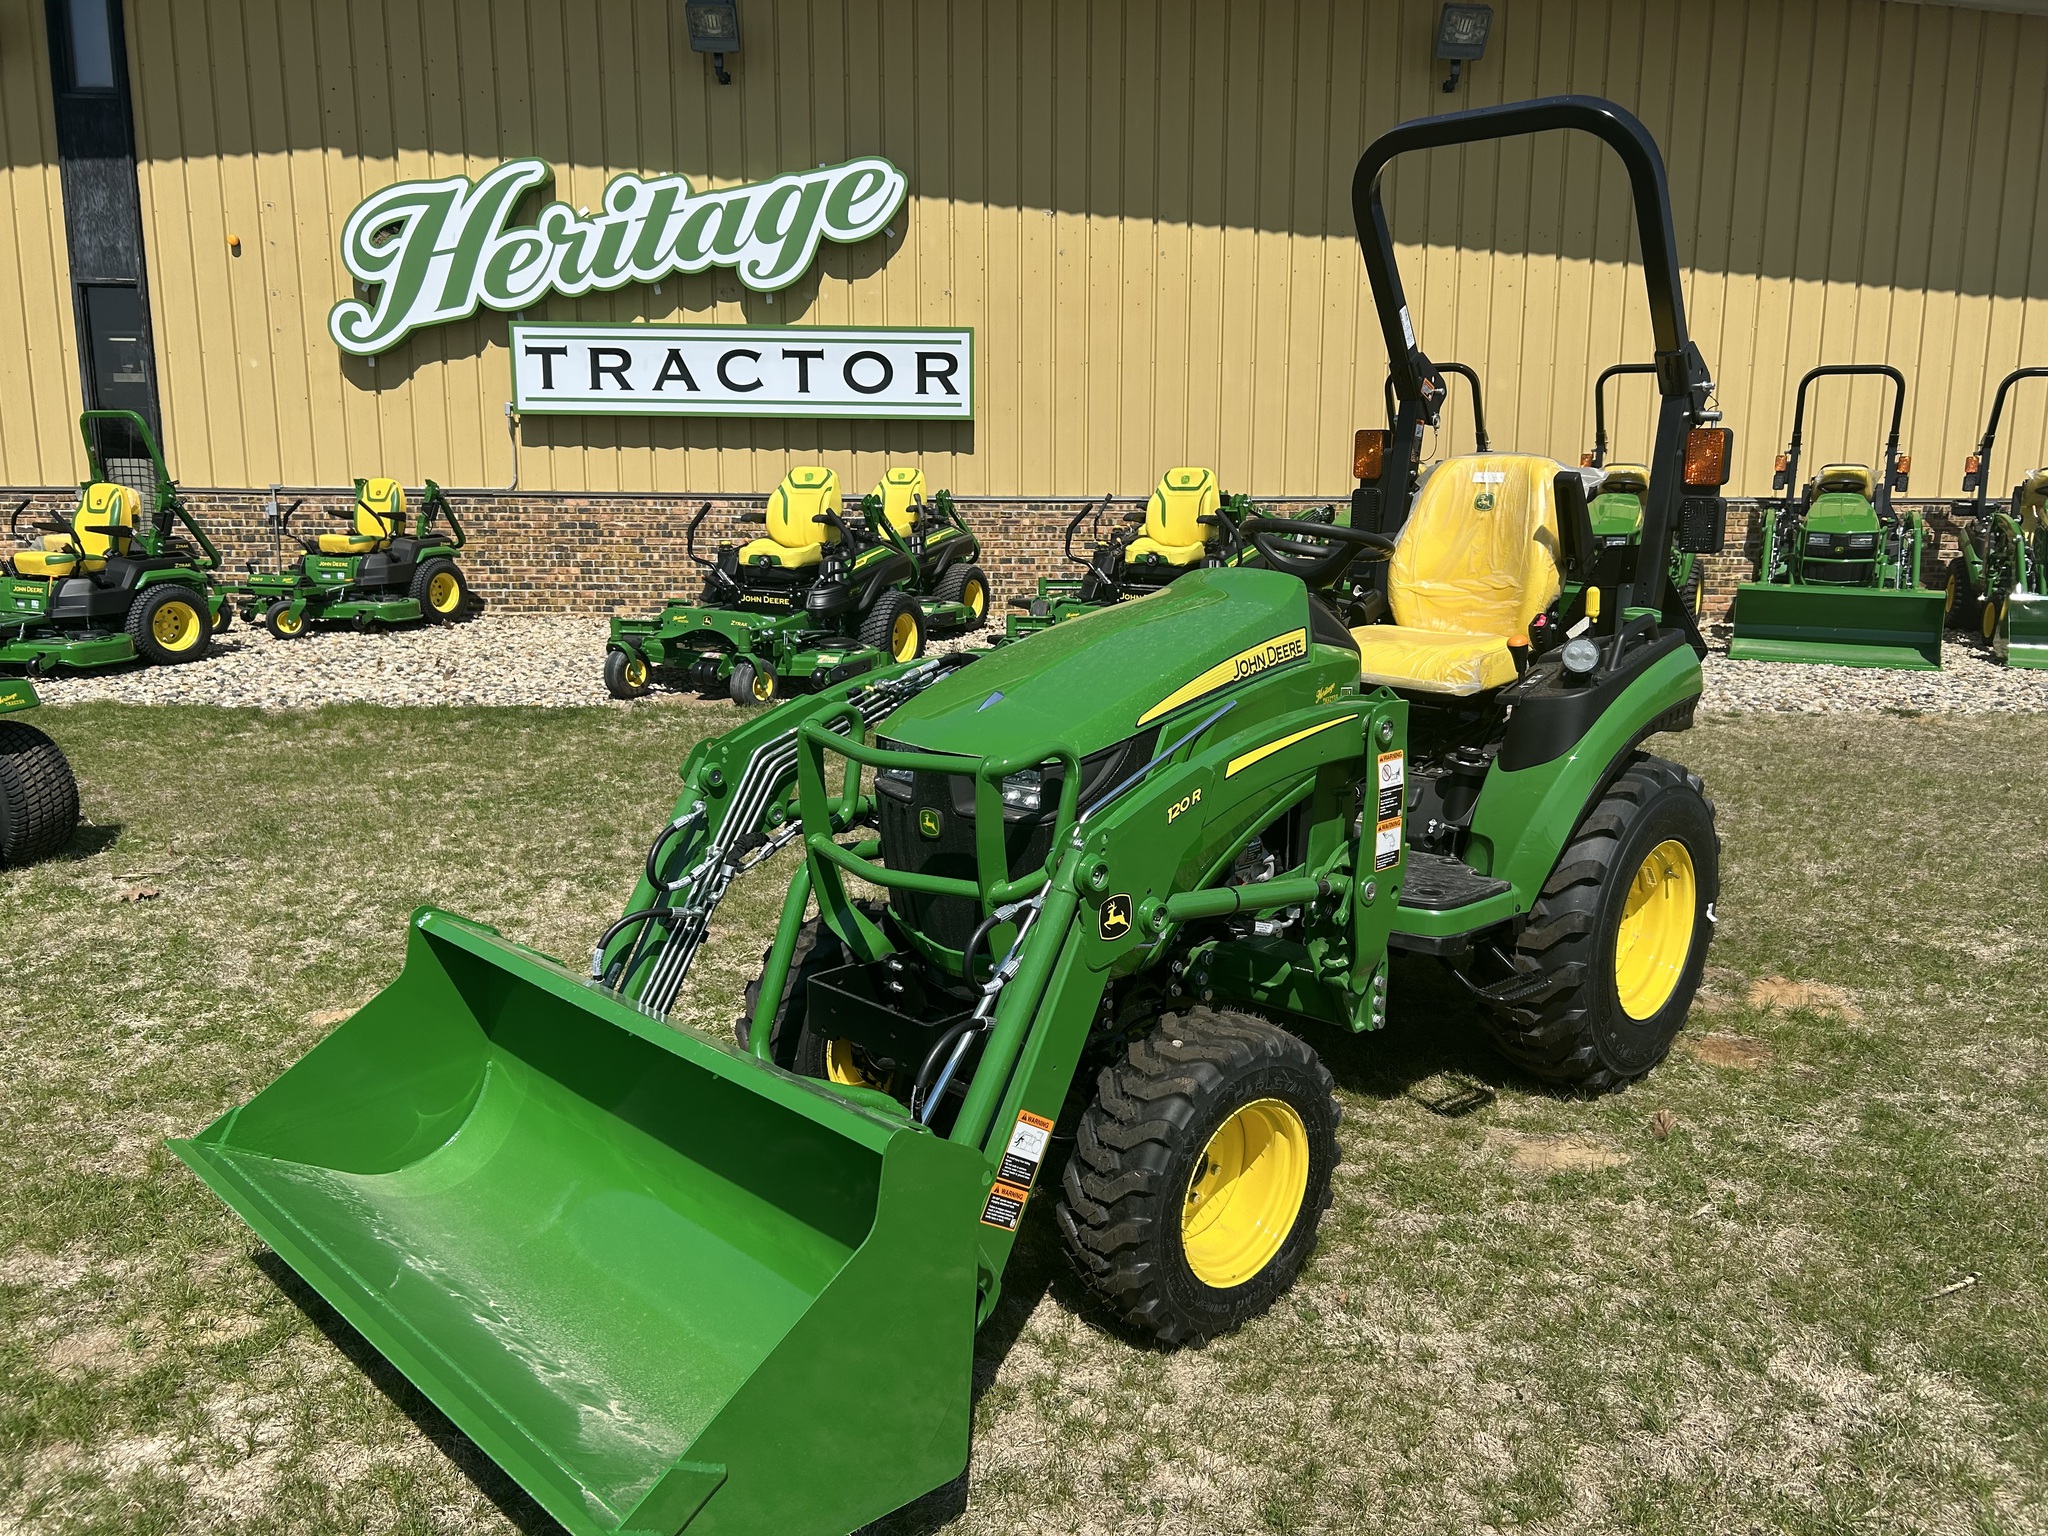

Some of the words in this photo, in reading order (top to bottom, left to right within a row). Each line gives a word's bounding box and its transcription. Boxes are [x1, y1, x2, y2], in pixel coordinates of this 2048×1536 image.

[333, 162, 899, 344] Heritage
[524, 344, 961, 396] TRACTOR
[12, 585, 27, 593] JOHN
[26, 585, 44, 594] DEERE
[740, 593, 762, 603] JOHN
[762, 595, 790, 606] DEERE
[1232, 651, 1267, 680] JOHN
[1266, 639, 1303, 666] DEERE
[1383, 751, 1403, 762] WARNING
[1381, 819, 1401, 831] WARNING
[1027, 1114, 1050, 1129] WARNING
[1001, 1186, 1024, 1201] WARNING
